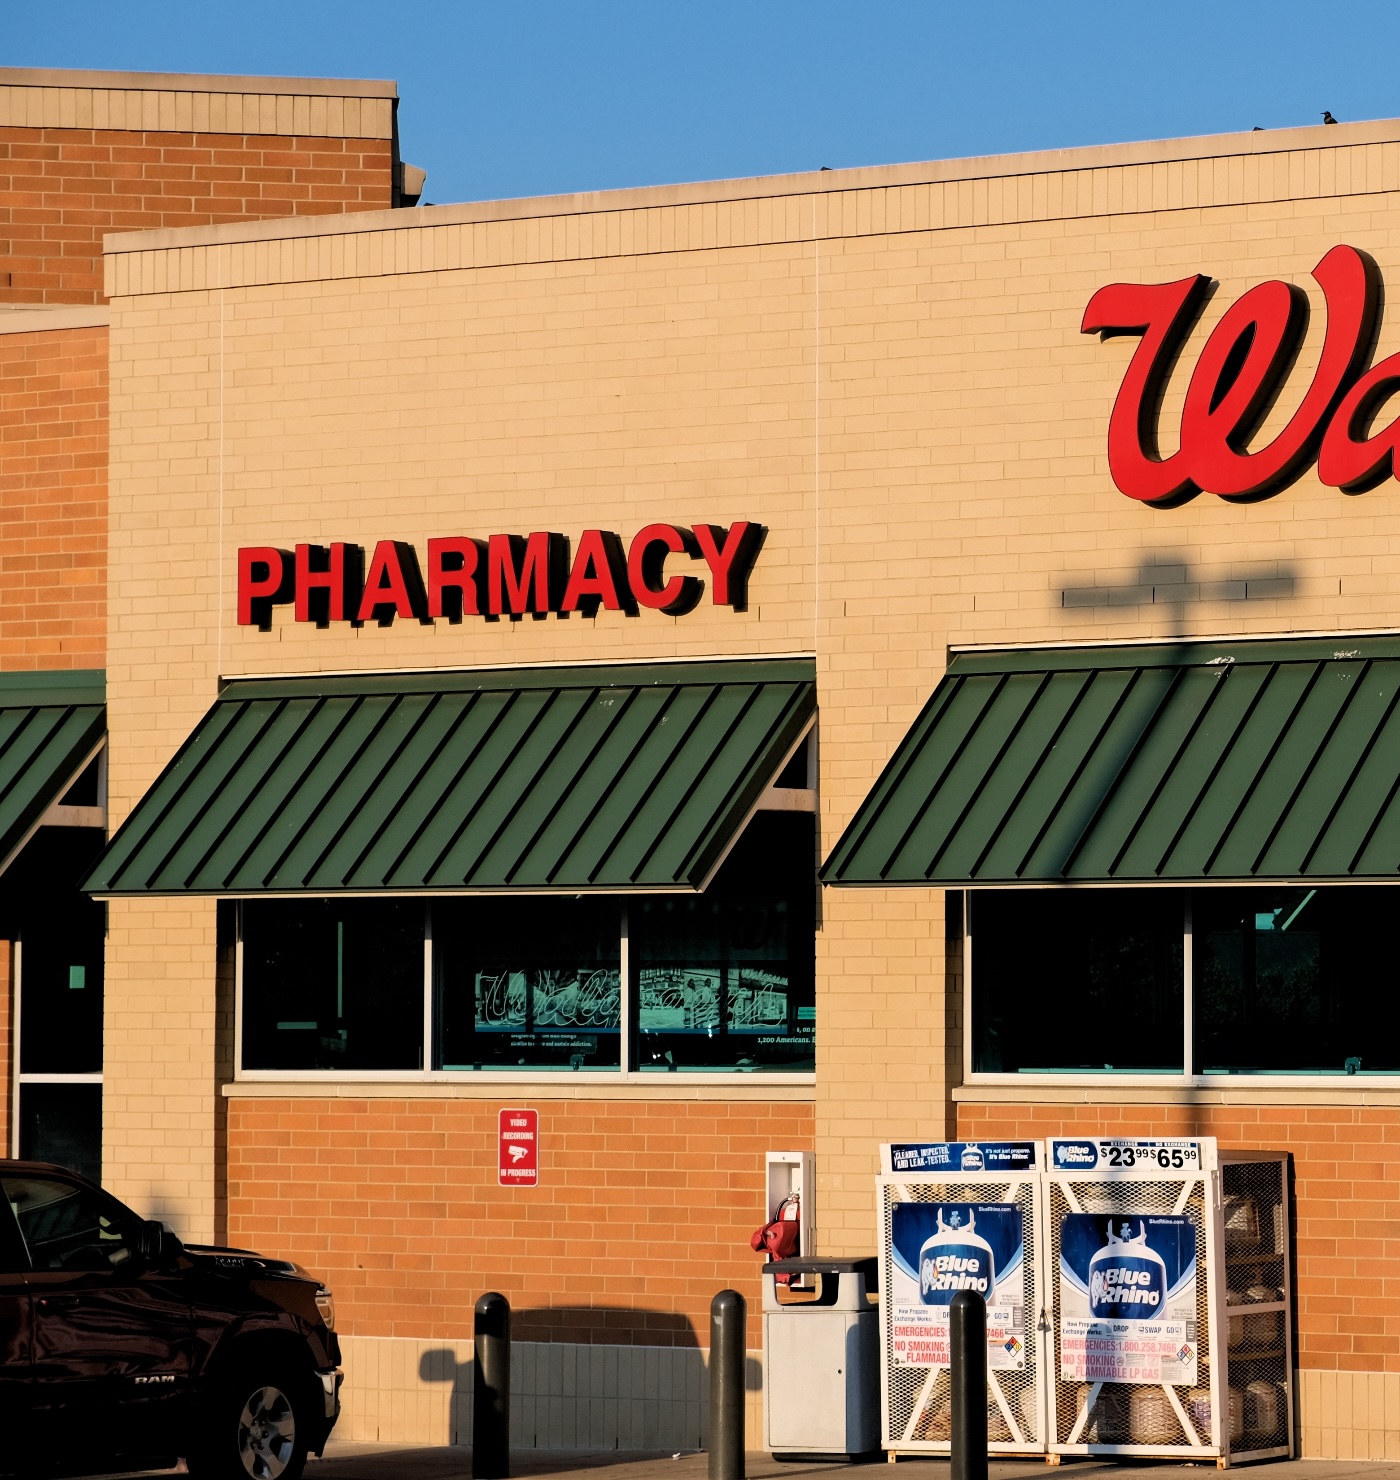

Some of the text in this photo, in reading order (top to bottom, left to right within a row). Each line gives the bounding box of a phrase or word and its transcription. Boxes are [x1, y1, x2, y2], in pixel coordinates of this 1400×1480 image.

[237, 521, 762, 630] PHARMACY
[510, 1118, 527, 1127] VIDEO
[503, 1132, 534, 1140] RECORDING
[1068, 1145, 1089, 1154] Blue
[1067, 1154, 1095, 1163] Rhino
[501, 1168, 536, 1177] IN PROGRESS
[936, 1255, 980, 1272] Blue
[931, 1272, 988, 1292] Rhino
[1106, 1267, 1151, 1285] Blue
[1101, 1285, 1160, 1306] Rhino
[1078, 1321, 1099, 1329] Propane
[1113, 1324, 1129, 1332] DROP
[894, 1326, 948, 1338] EMERGENCIES:
[1062, 1328, 1086, 1336] Exchange
[894, 1340, 945, 1352] NO SMOKING
[906, 1352, 951, 1364] FLAMMABL
[1062, 1354, 1075, 1365] NO
[1077, 1354, 1116, 1366] SMOKING
[1075, 1366, 1159, 1379] FLAMMABLE LP GAS
[134, 1375, 176, 1385] RAM
